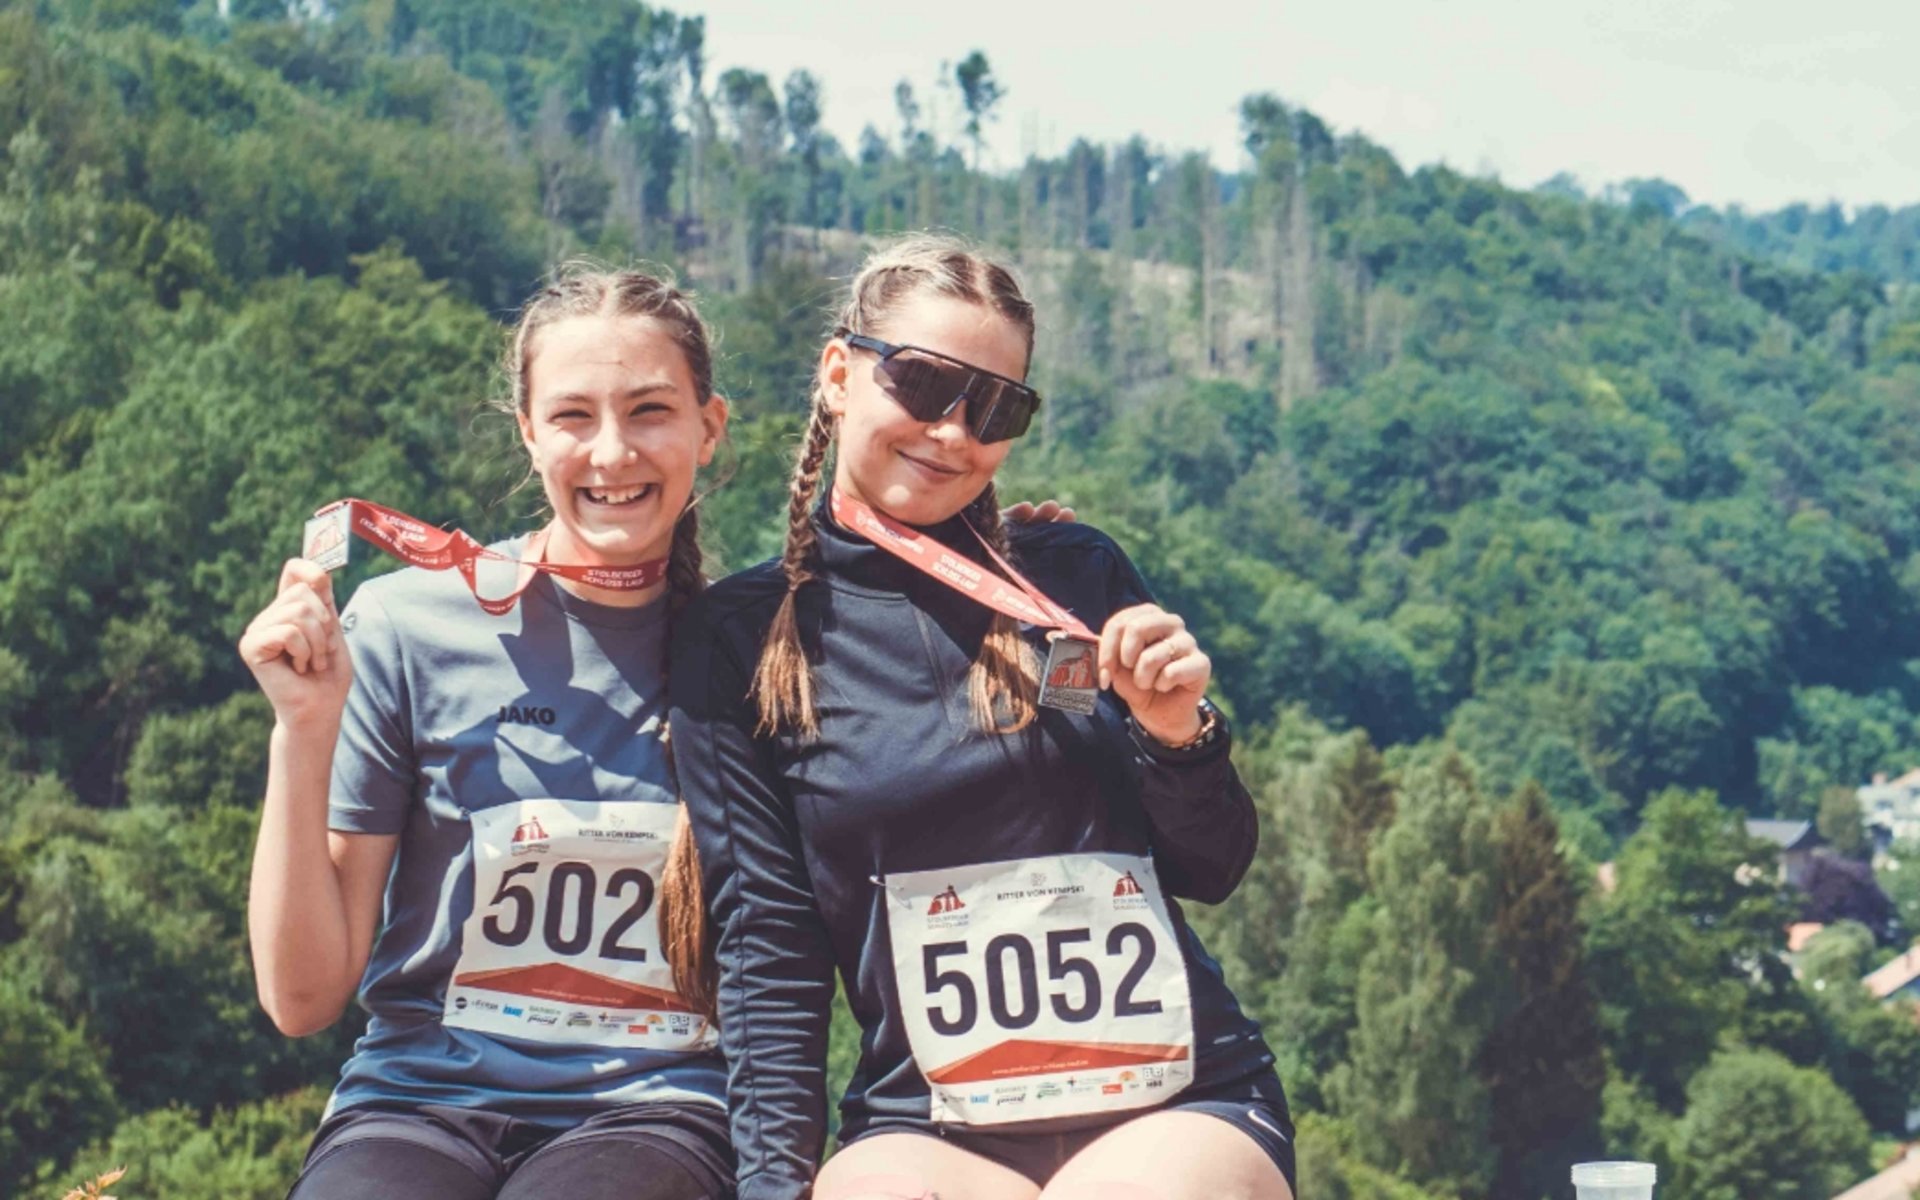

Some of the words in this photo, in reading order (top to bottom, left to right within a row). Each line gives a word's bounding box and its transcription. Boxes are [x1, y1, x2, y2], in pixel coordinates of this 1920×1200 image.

[587, 569, 643, 579] STOLBERGER
[496, 705, 556, 725] JAKO
[997, 892, 1024, 900] RITTER
[1027, 889, 1045, 897] VON
[1047, 885, 1084, 895] KEMPSKI
[482, 861, 673, 966] 502
[922, 922, 1163, 1037] 5052
